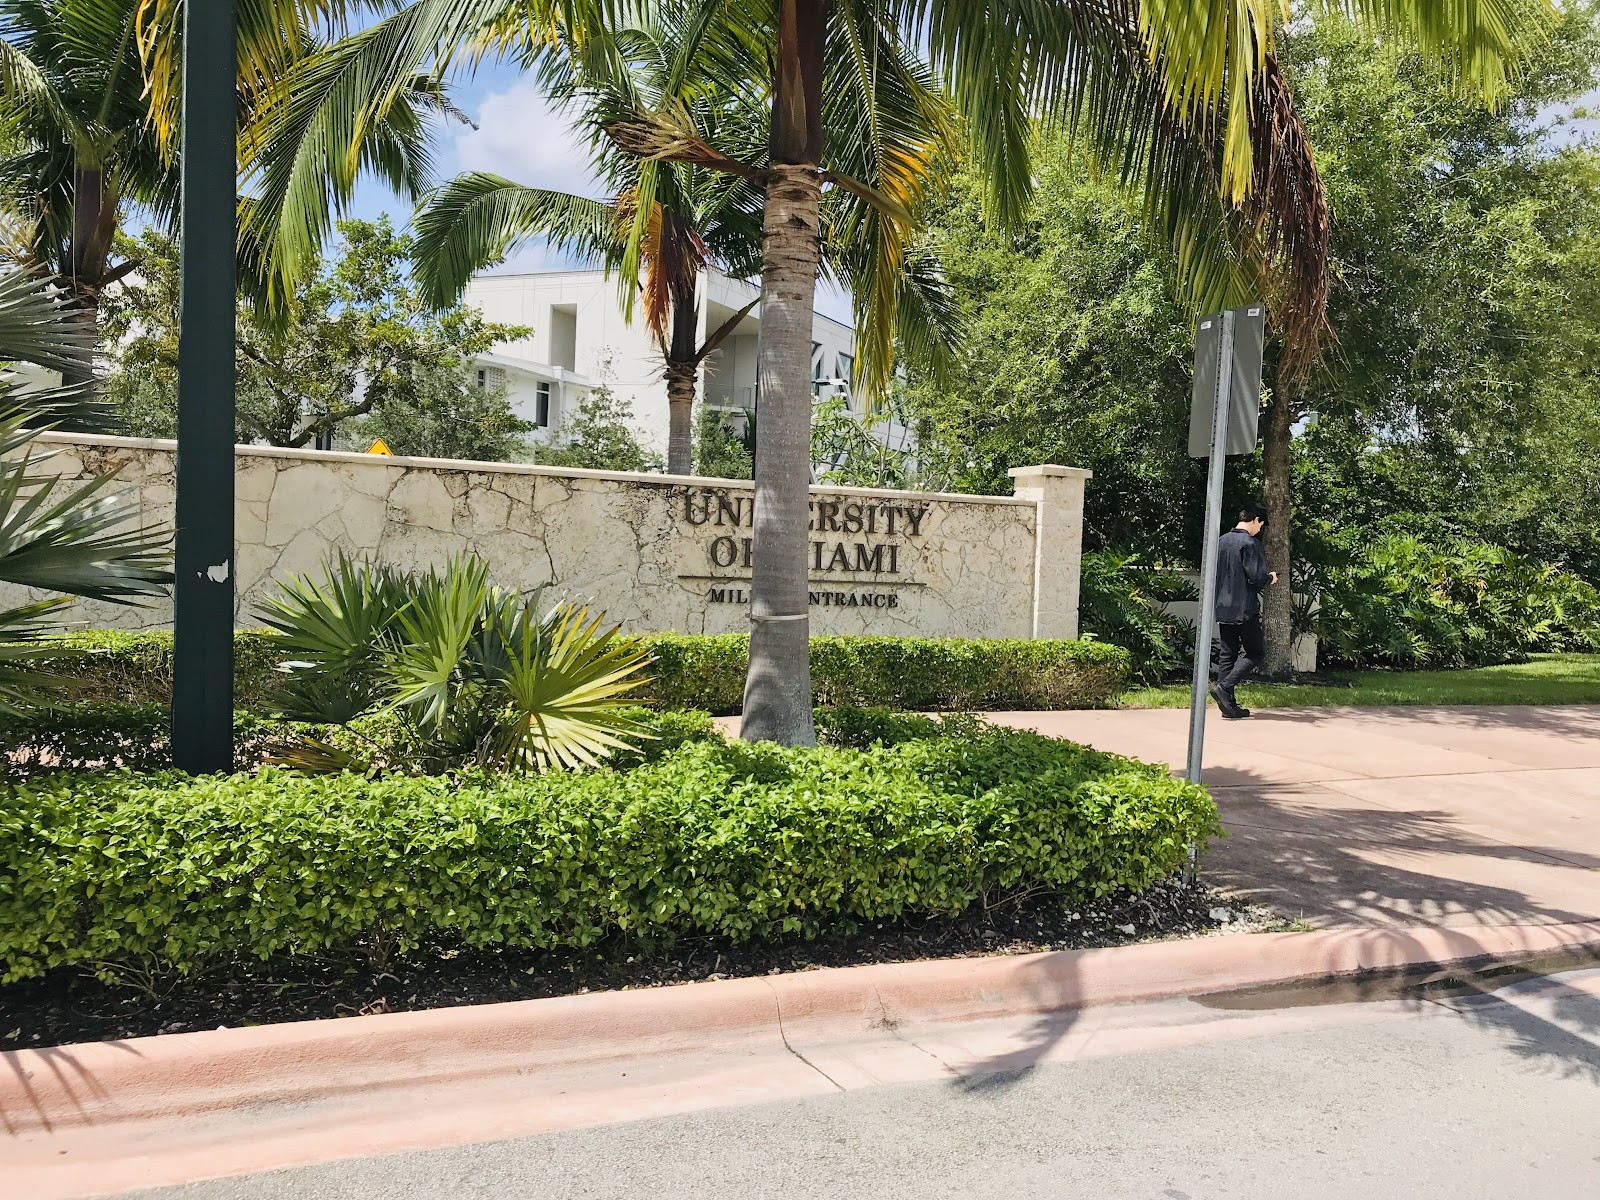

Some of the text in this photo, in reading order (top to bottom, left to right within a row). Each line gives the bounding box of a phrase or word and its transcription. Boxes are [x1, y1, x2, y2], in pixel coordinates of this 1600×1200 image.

[684, 494, 929, 536] UNIRSITY
[808, 541, 901, 574] IAMI
[709, 588, 899, 608] MIL NTRANCE
